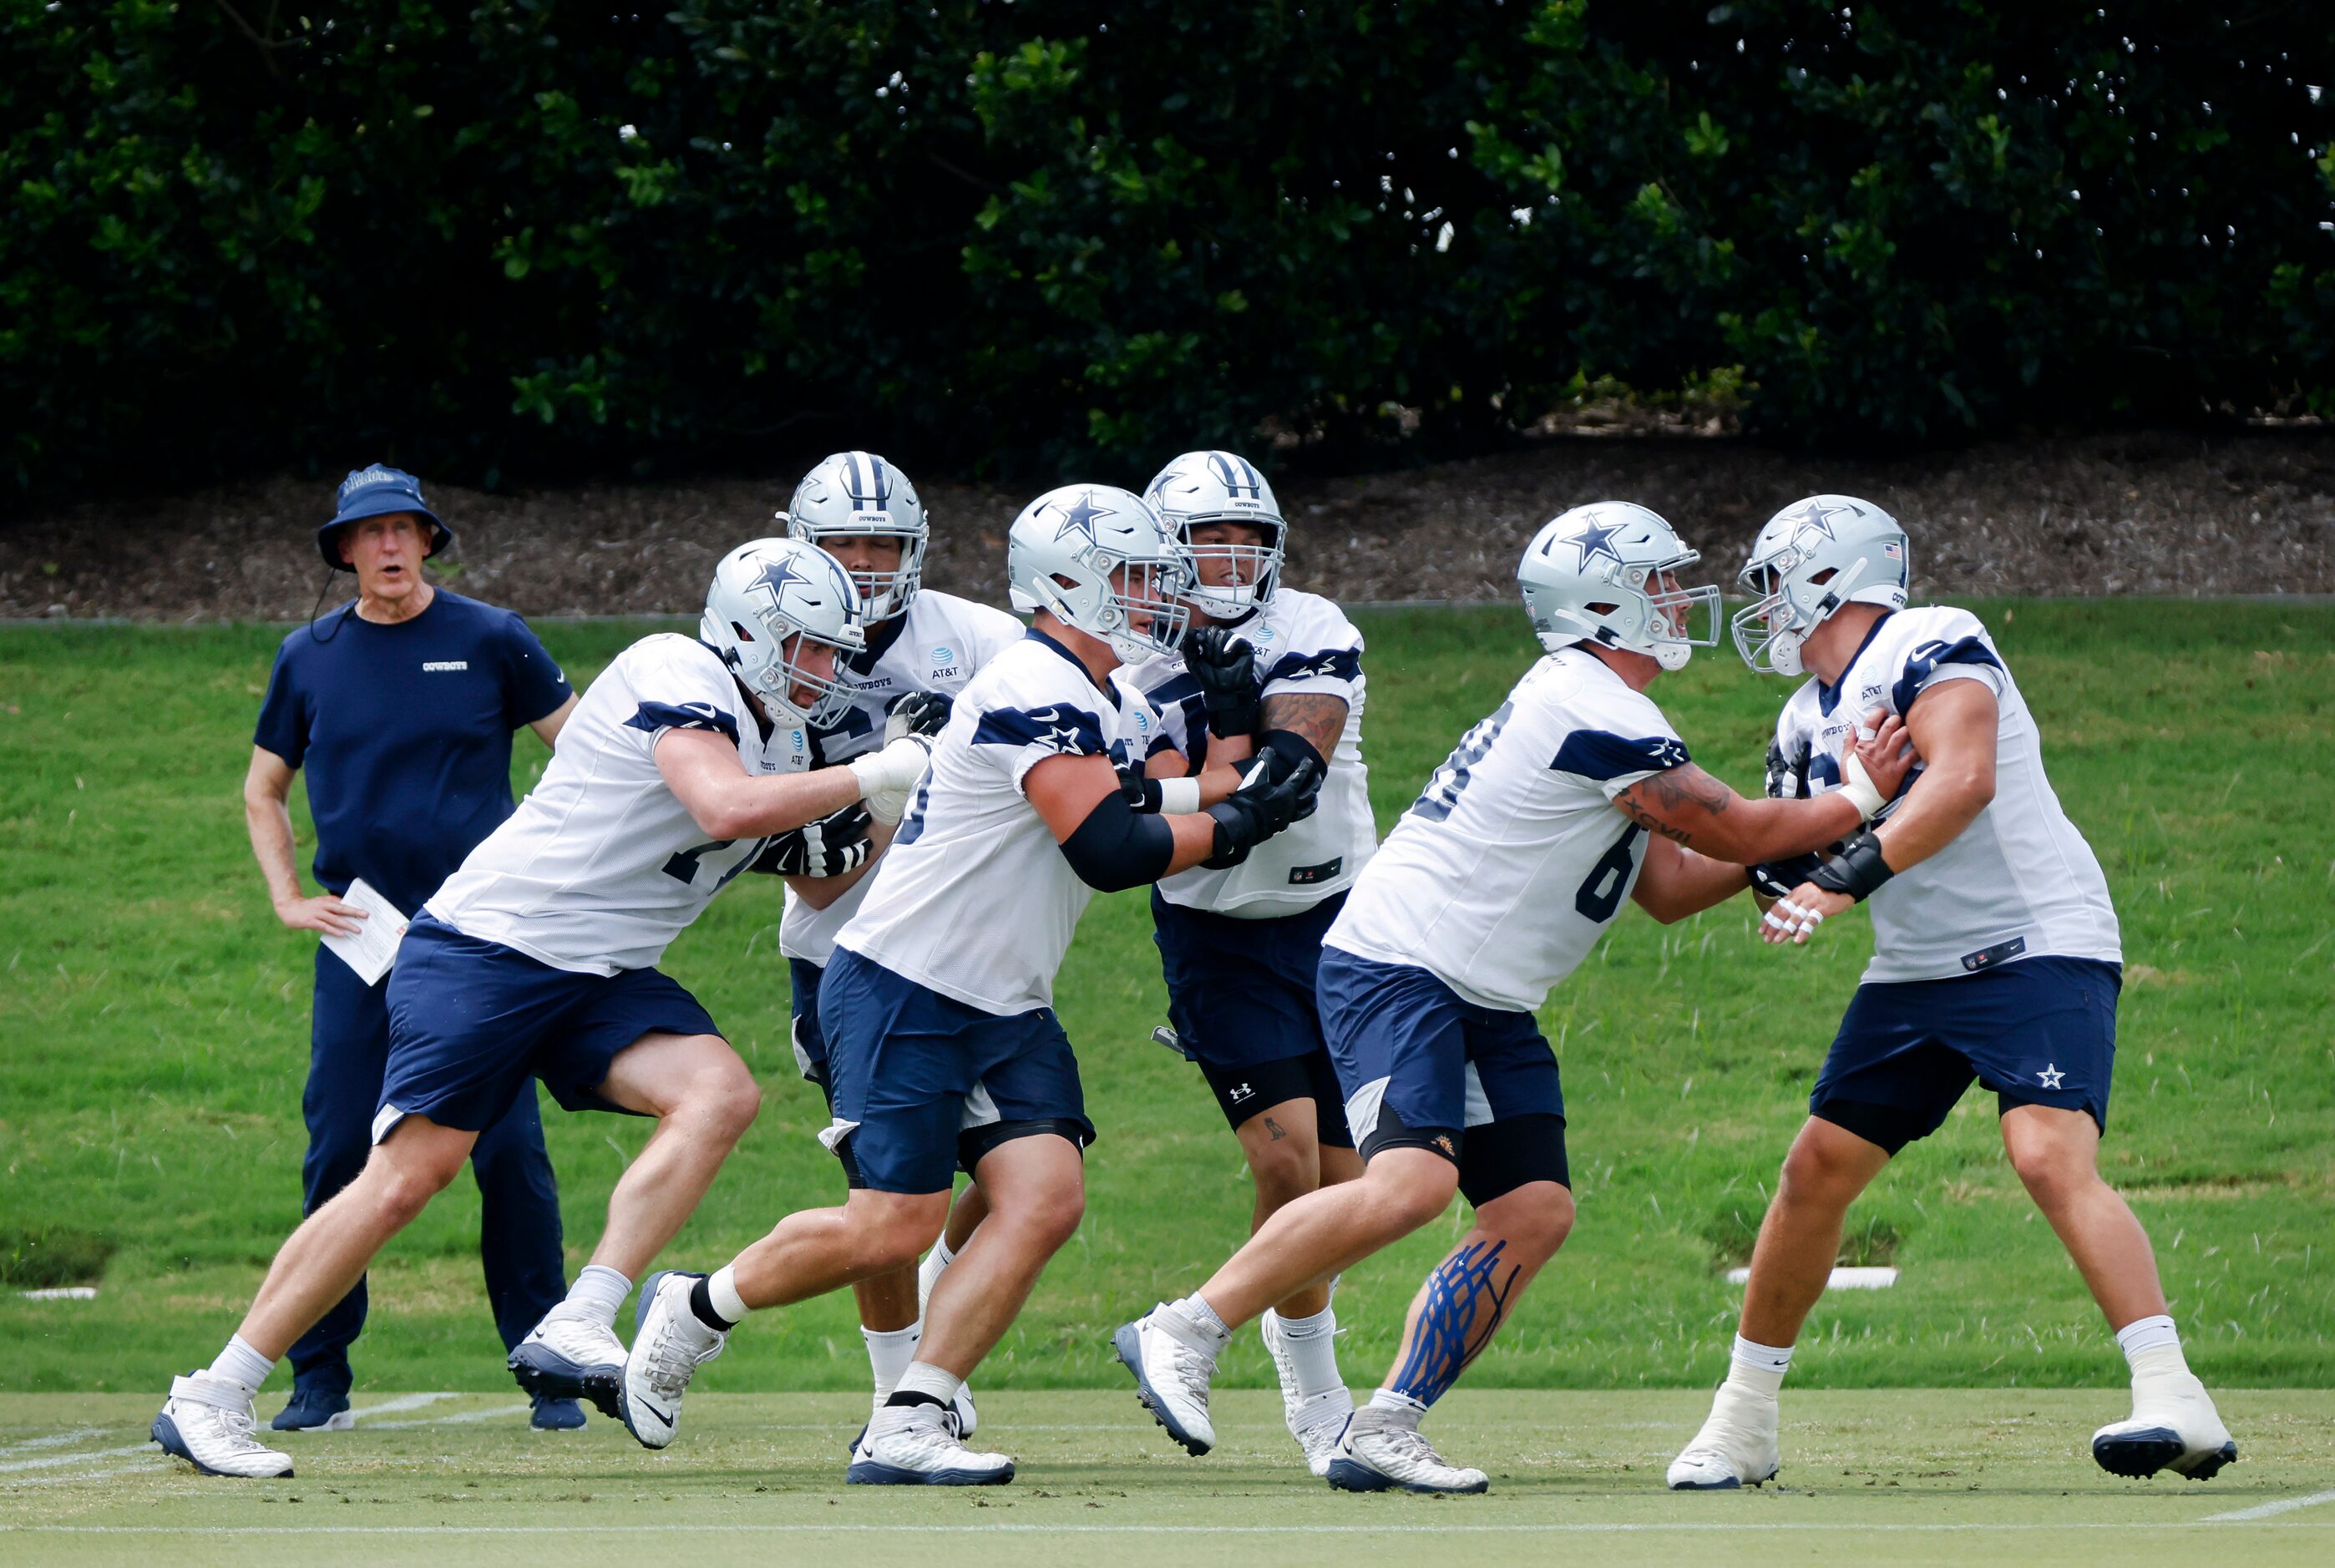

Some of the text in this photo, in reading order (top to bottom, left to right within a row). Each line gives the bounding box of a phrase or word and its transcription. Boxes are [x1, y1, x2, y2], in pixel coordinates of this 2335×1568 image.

[423, 661, 468, 671] COWBOYS
[932, 666, 959, 680] AT&T
[847, 677, 892, 691] OWBOYS
[1861, 685, 1882, 701] AT&T
[791, 755, 803, 766] AT&T
